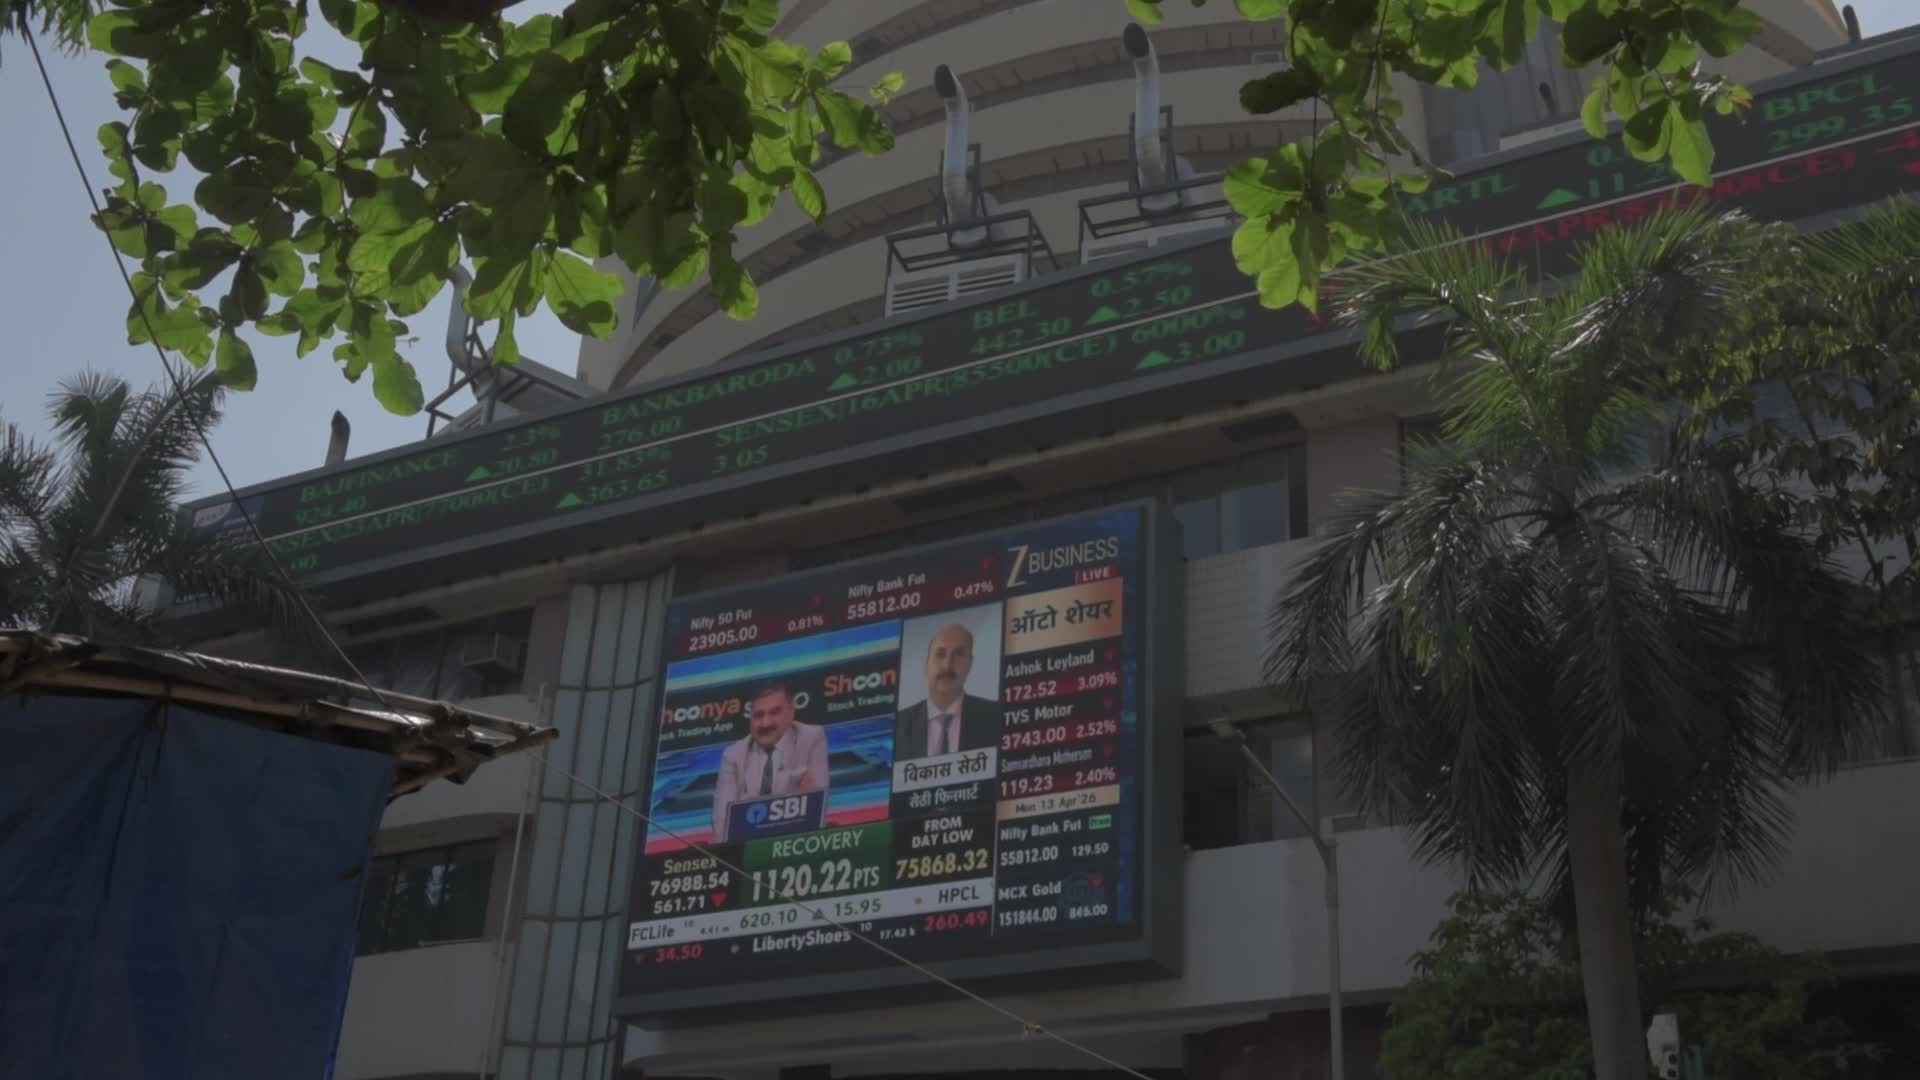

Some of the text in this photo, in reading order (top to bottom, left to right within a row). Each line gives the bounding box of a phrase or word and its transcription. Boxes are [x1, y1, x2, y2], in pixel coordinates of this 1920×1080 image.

[1762, 71, 1891, 122] BPCL
[1766, 96, 1914, 154] 299.35
[973, 301, 1037, 330] BEL
[601, 358, 817, 426] BANKBARODA
[1028, 536, 1119, 575] BUSINESS
[848, 573, 926, 599] Nifty Bank Fut
[1082, 565, 1109, 582] LIVE
[953, 580, 994, 600] 0.47%
[847, 592, 921, 620] 55812.00
[1010, 599, 1114, 634] ऑटो शेयर
[690, 608, 753, 632] Nifty 50 Fut
[787, 615, 825, 633] 0.81%
[688, 625, 758, 652] 23905.00
[1005, 648, 1095, 678] Ashok Leyland
[824, 670, 896, 696] Shoon
[1004, 671, 1118, 703] 172.52 3.09%
[1004, 704, 1073, 726] TVS Motor
[1001, 719, 1117, 751] 3743.00 2.52%
[903, 752, 989, 783] विकास सेठी
[1000, 766, 1116, 797] 119.23 2.40%
[768, 796, 808, 822] SBI
[1041, 799, 1054, 809] 13
[924, 816, 962, 833] FROM
[1000, 828, 1028, 841] Nifty
[1031, 822, 1059, 837] Bank
[1063, 819, 1082, 833] Fut
[772, 830, 864, 858] RECOVERY
[911, 828, 974, 848] DAY LOW
[663, 857, 718, 875] Sensex
[895, 848, 989, 880] 75868.32
[1000, 842, 1109, 867] 55812.00 129.50
[650, 871, 729, 896] 76988.54
[998, 881, 1062, 901] MCX Gold
[631, 925, 675, 942] FCLife
[739, 909, 798, 929] 620.10
[834, 898, 882, 917] 15.95
[938, 886, 979, 905] HPCL
[653, 895, 705, 914] 561.71
[999, 906, 1057, 928] 151844.00
[656, 944, 704, 963] 34.50
[752, 929, 852, 953] LibertyShoes
[860, 921, 872, 932] 10
[923, 911, 988, 933] 260.49
